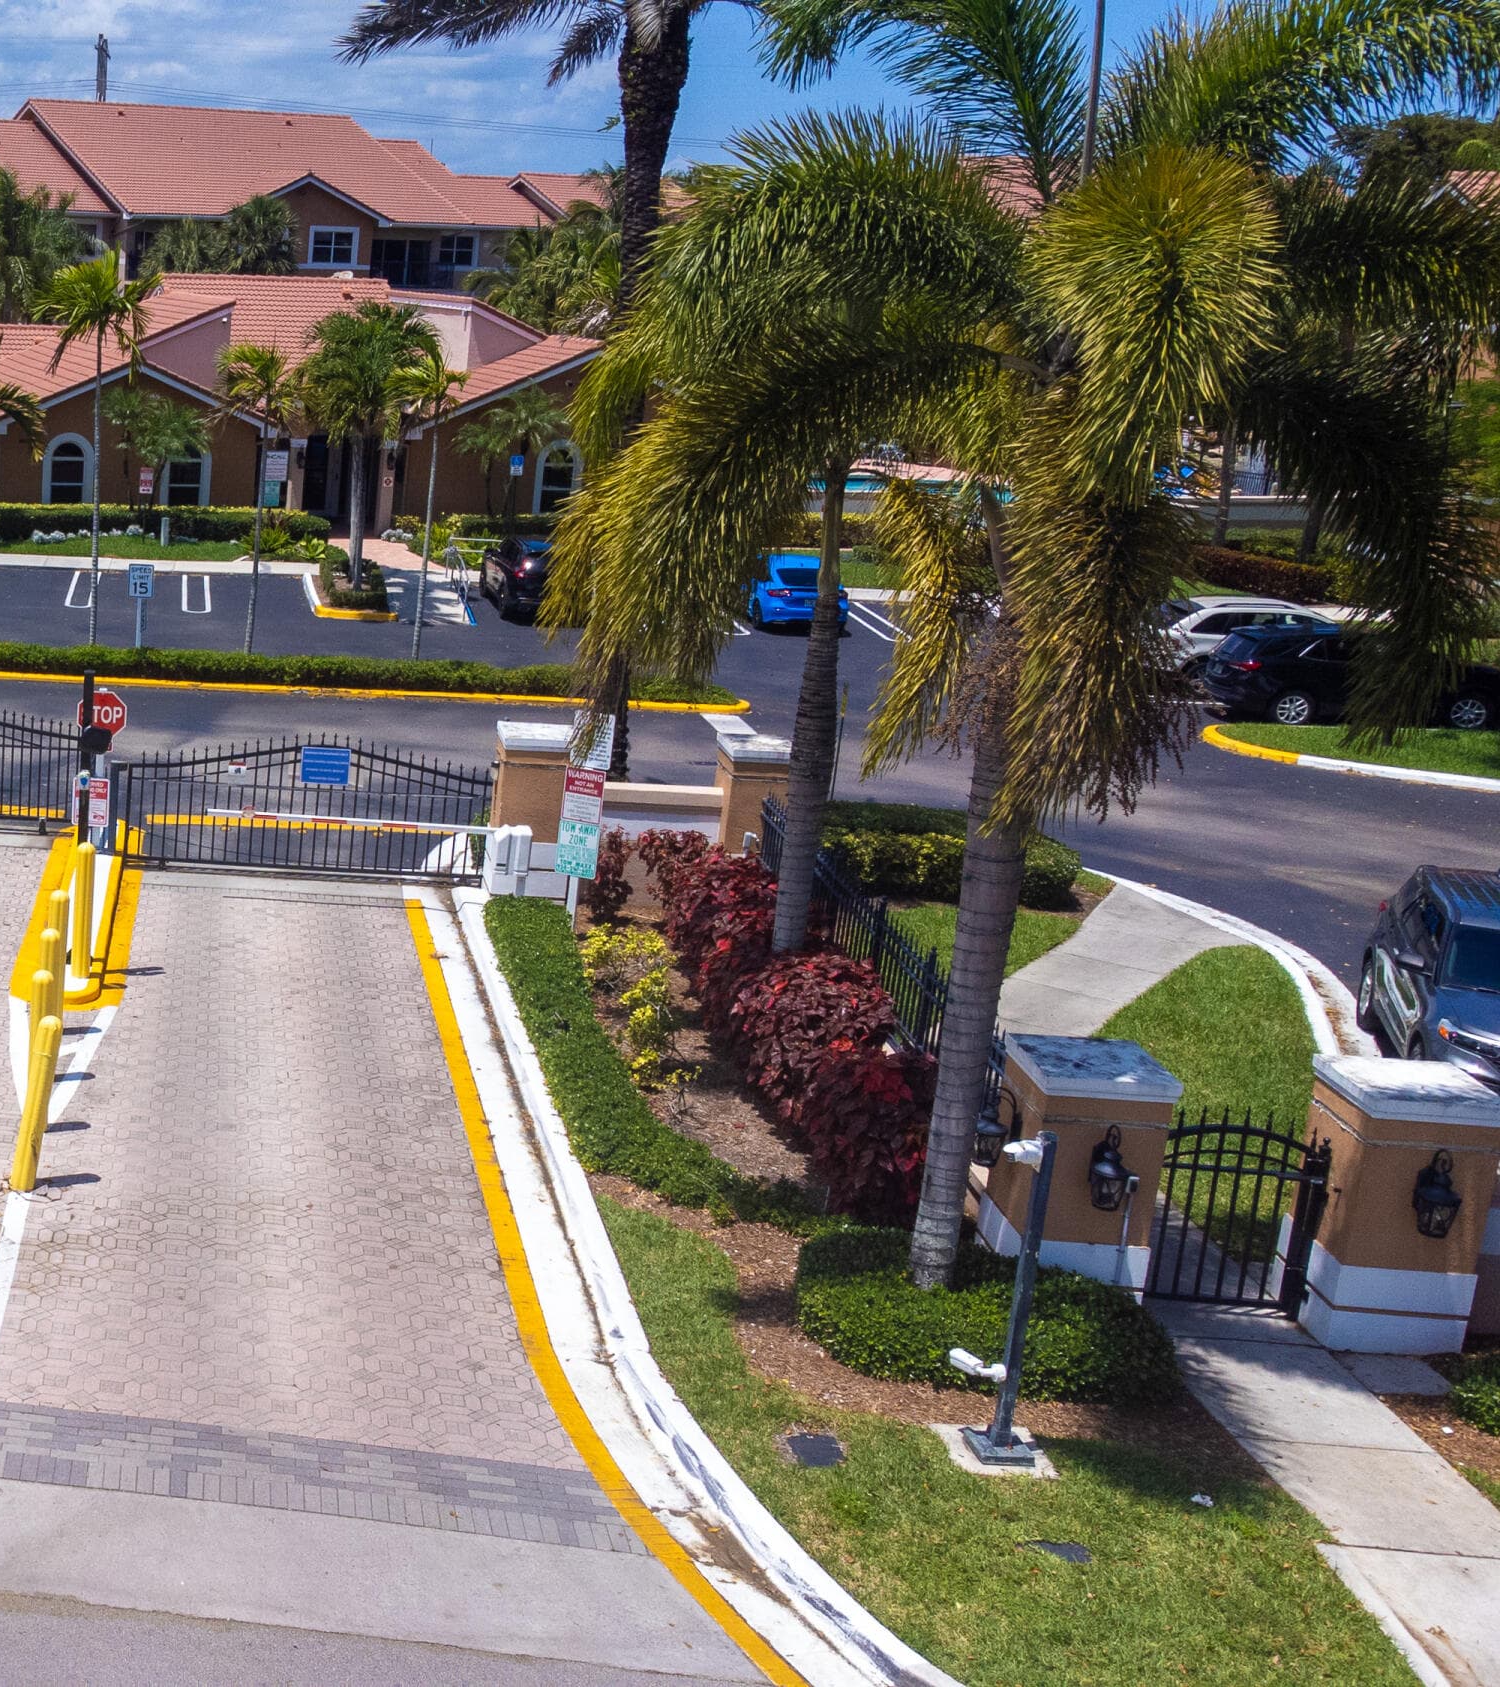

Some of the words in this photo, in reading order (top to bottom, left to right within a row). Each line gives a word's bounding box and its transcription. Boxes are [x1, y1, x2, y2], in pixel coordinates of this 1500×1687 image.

[132, 582, 149, 595] 15
[81, 705, 123, 724] TOP
[568, 769, 604, 783] WARNING
[569, 785, 598, 796] ENTRANCE
[561, 821, 577, 833] TOW
[579, 825, 598, 837] AWAY
[568, 834, 588, 848] ZONE
